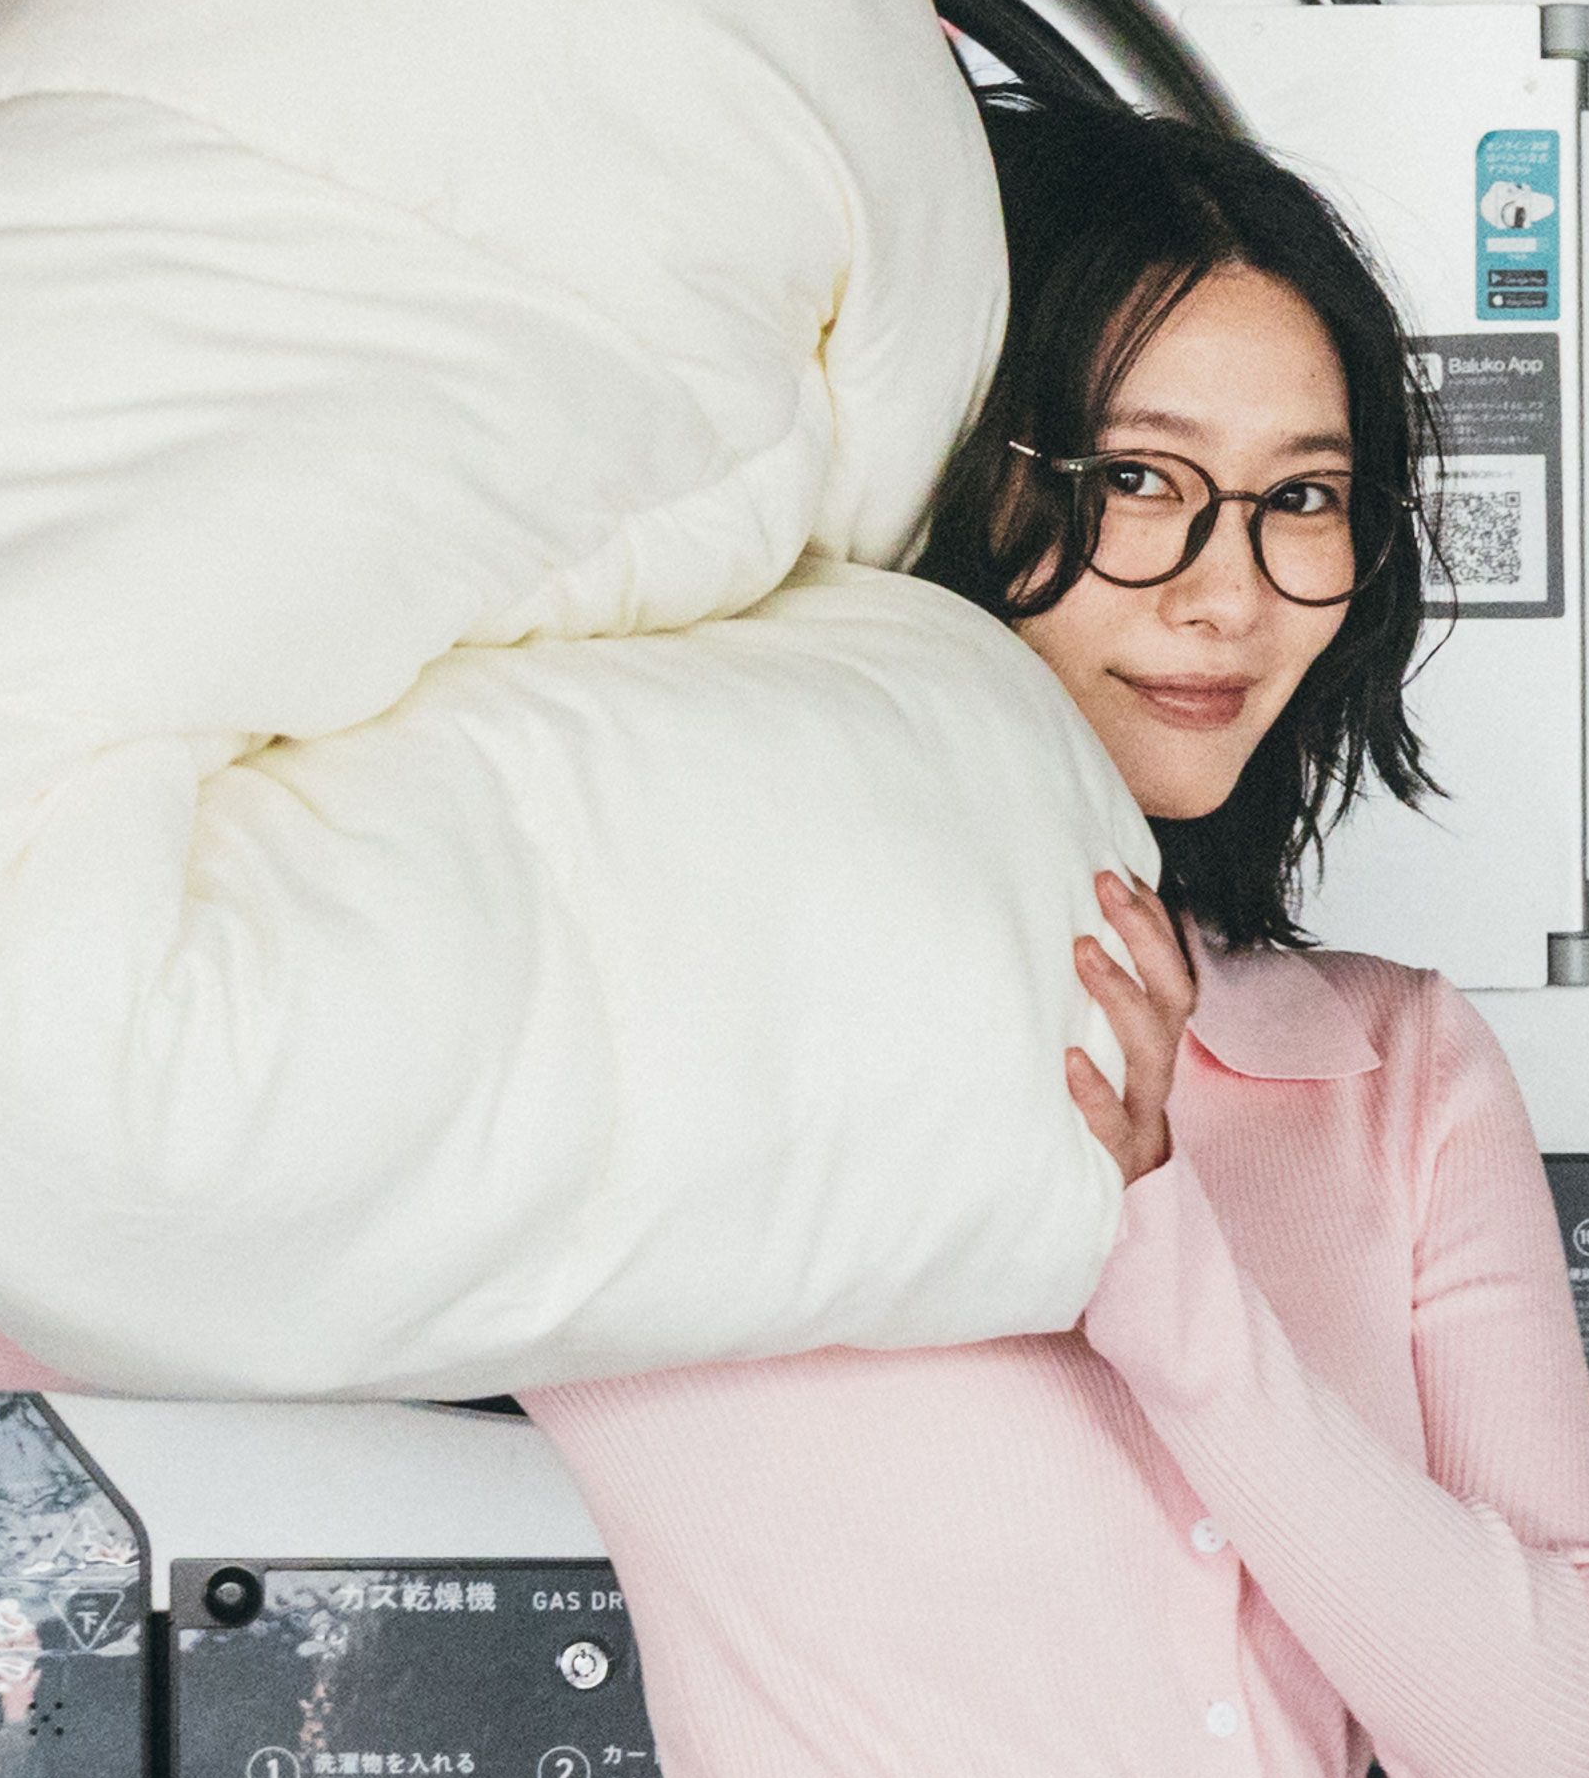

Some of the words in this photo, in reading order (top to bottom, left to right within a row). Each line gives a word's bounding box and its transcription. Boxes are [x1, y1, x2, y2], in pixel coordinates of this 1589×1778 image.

[1448, 356, 1505, 375] Baluko
[1507, 356, 1543, 376] App
[532, 1591, 581, 1611] GAS
[314, 1752, 476, 1776] 洗濯物を入れる
